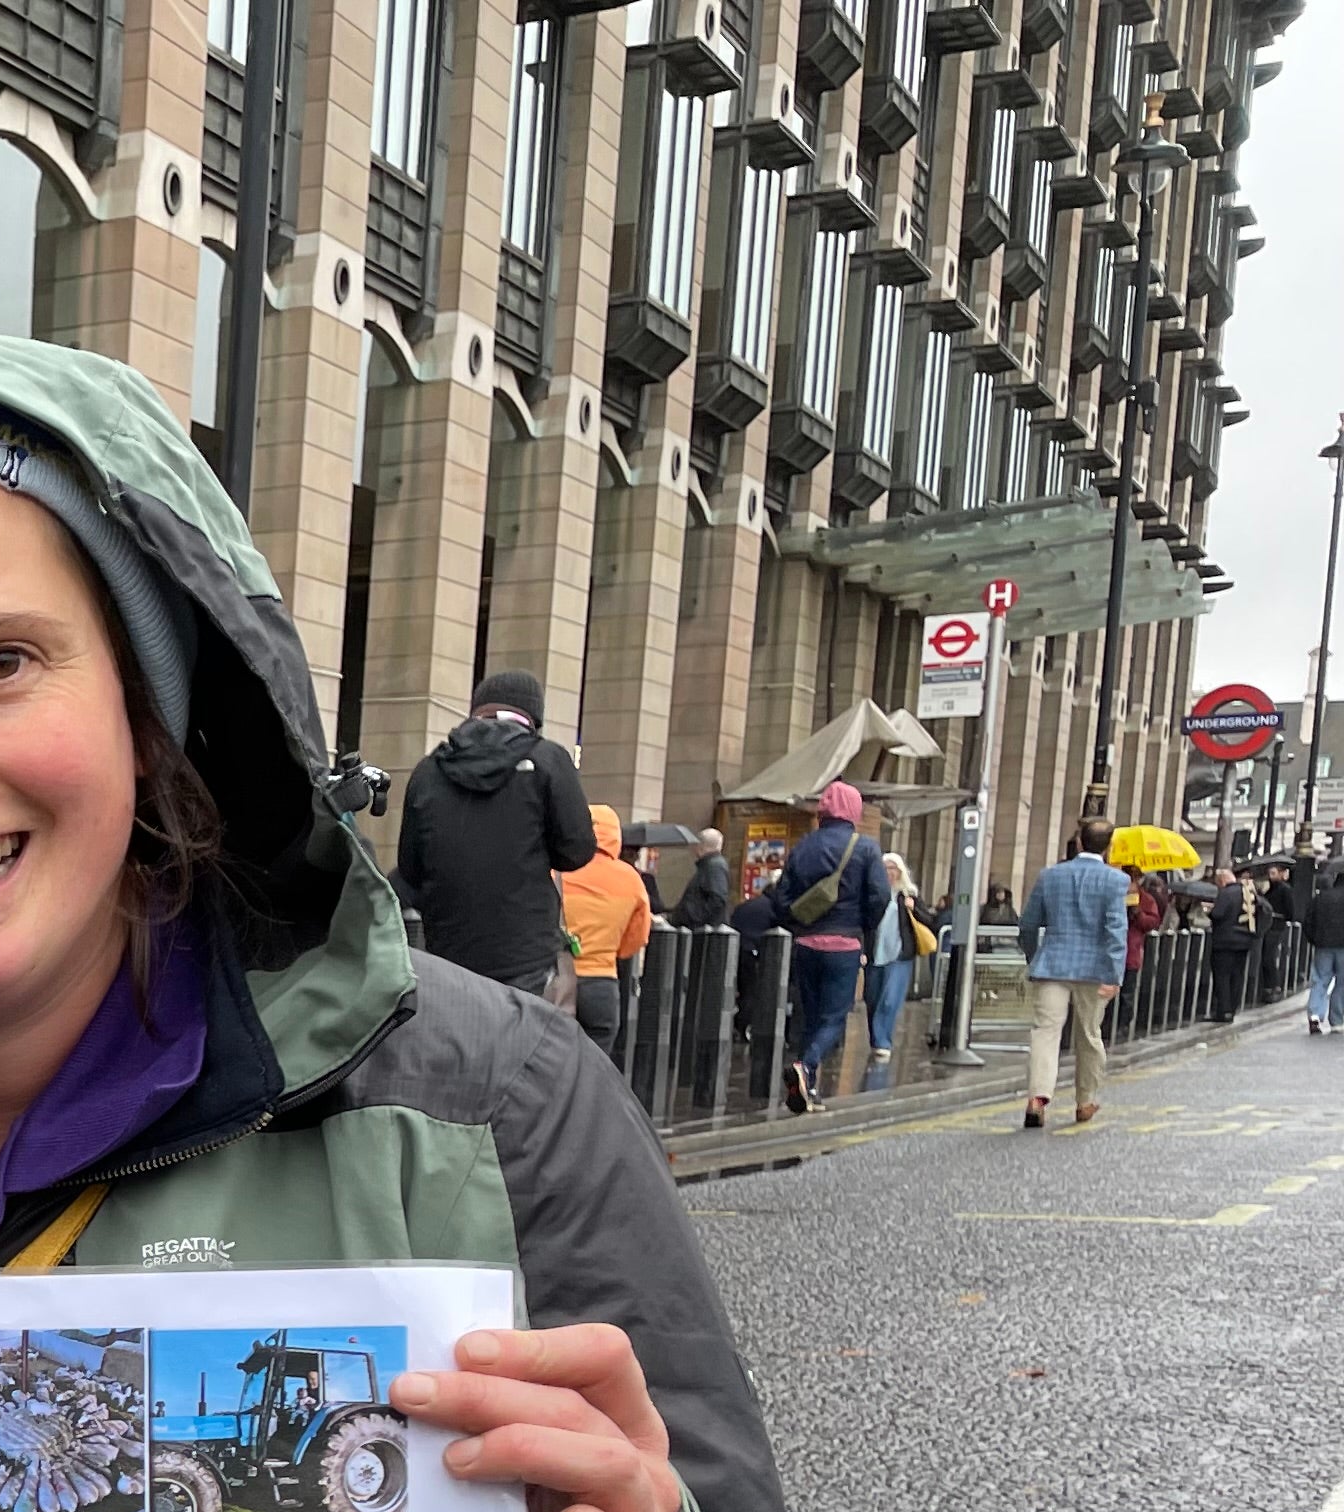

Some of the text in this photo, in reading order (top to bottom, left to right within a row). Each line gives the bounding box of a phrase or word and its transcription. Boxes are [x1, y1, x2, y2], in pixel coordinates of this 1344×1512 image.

[989, 582, 1012, 608] H
[1186, 715, 1279, 729] UNDERGROUND
[141, 1237, 217, 1258] REGATTA
[143, 1253, 185, 1268] GREAT
